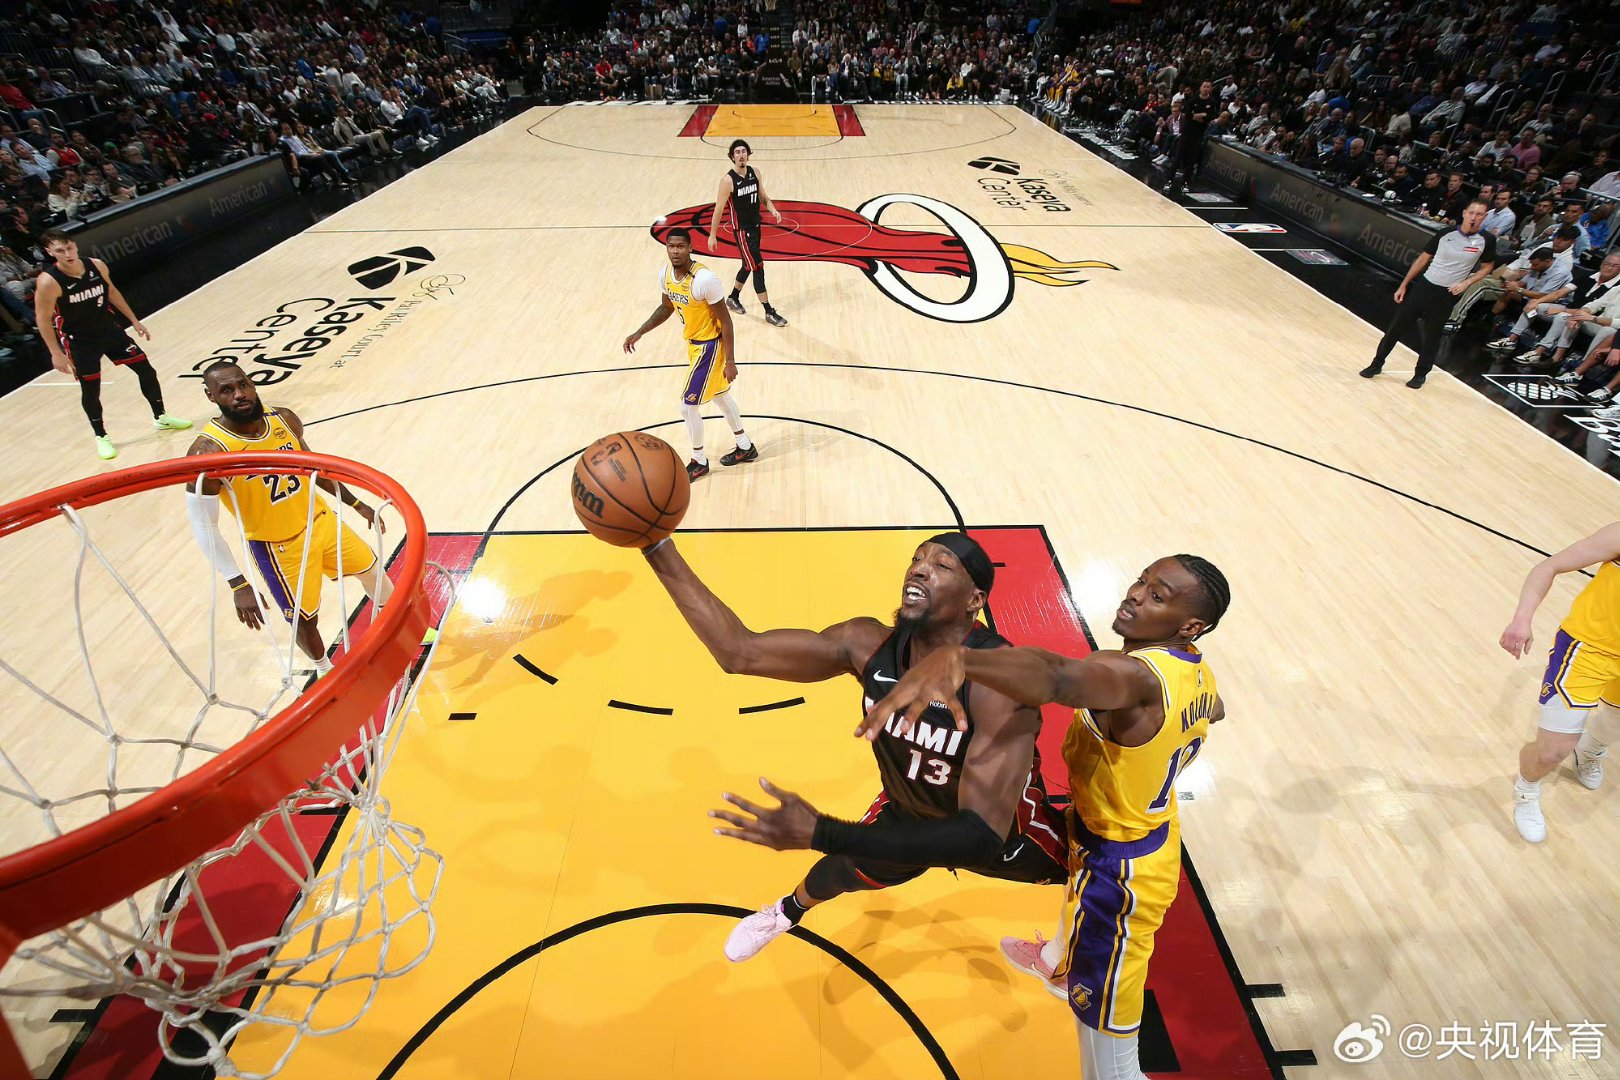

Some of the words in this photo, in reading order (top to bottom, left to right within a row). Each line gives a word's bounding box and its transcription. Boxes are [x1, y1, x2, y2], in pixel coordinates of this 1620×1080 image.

[1207, 152, 1247, 185] American
[208, 181, 268, 217] American
[737, 183, 757, 197] MIAMI
[977, 177, 1027, 211] Center
[1013, 178, 1072, 212] Kaseya
[1270, 183, 1325, 222] American
[91, 220, 173, 264] American
[1357, 223, 1417, 267] Americ
[69, 284, 104, 304] MIAMI
[248, 297, 397, 387] Kaseya
[262, 474, 301, 506] 23
[929, 700, 950, 710] Robin
[907, 749, 952, 786] 13
